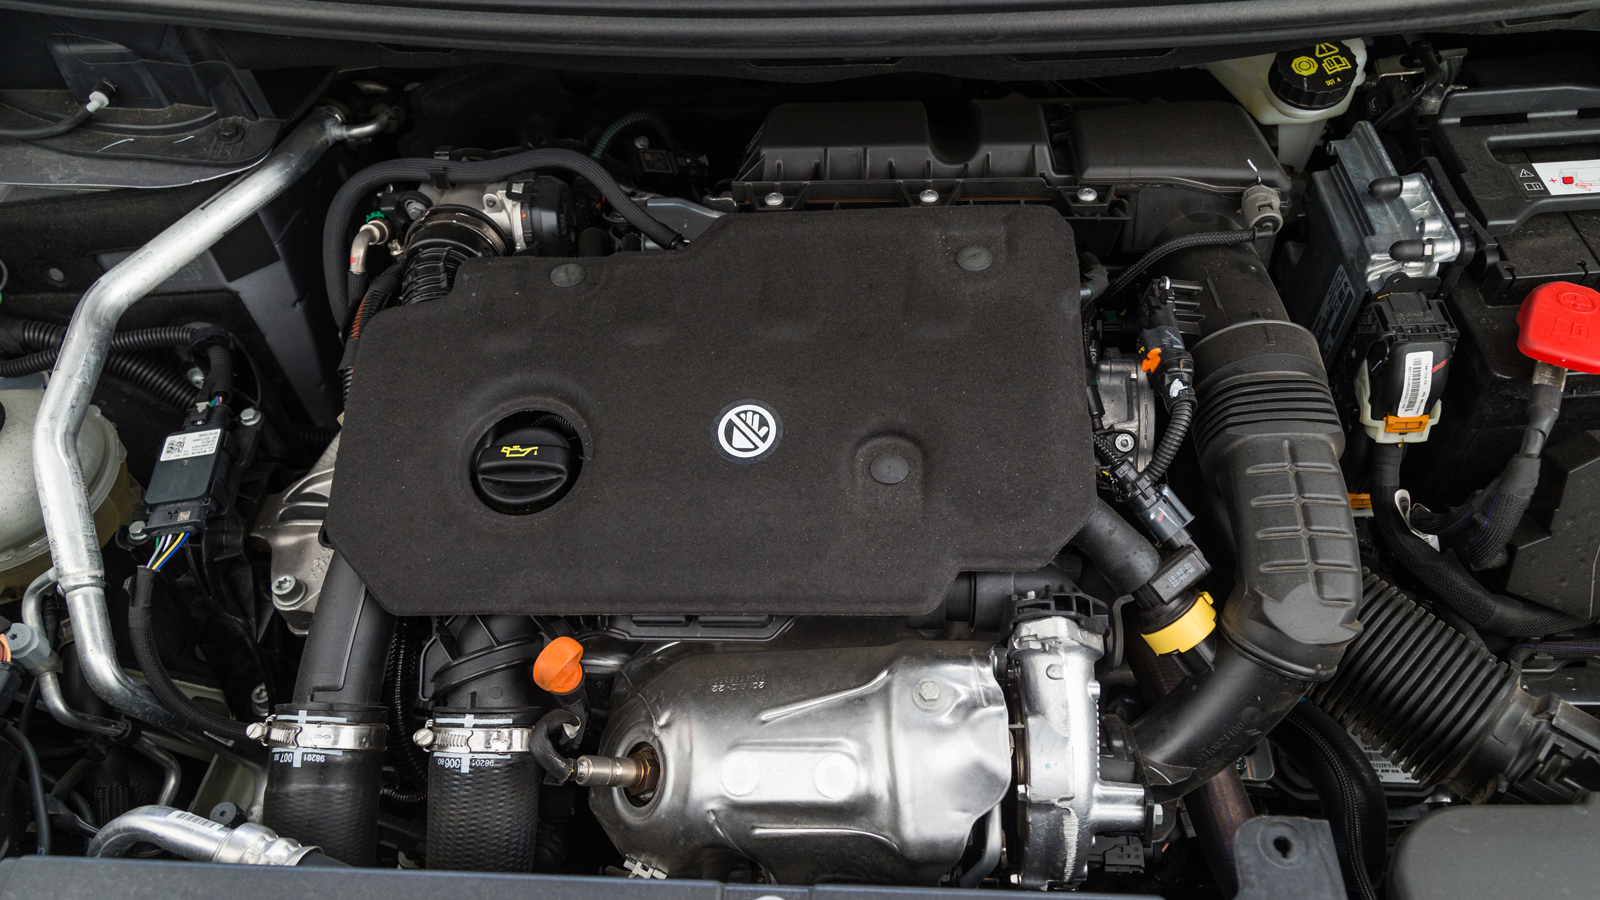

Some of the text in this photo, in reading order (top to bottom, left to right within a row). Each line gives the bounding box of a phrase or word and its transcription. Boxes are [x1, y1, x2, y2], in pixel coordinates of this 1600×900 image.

[1325, 78, 1336, 86] DOT
[280, 753, 293, 763] 007
[303, 754, 326, 763] 98201
